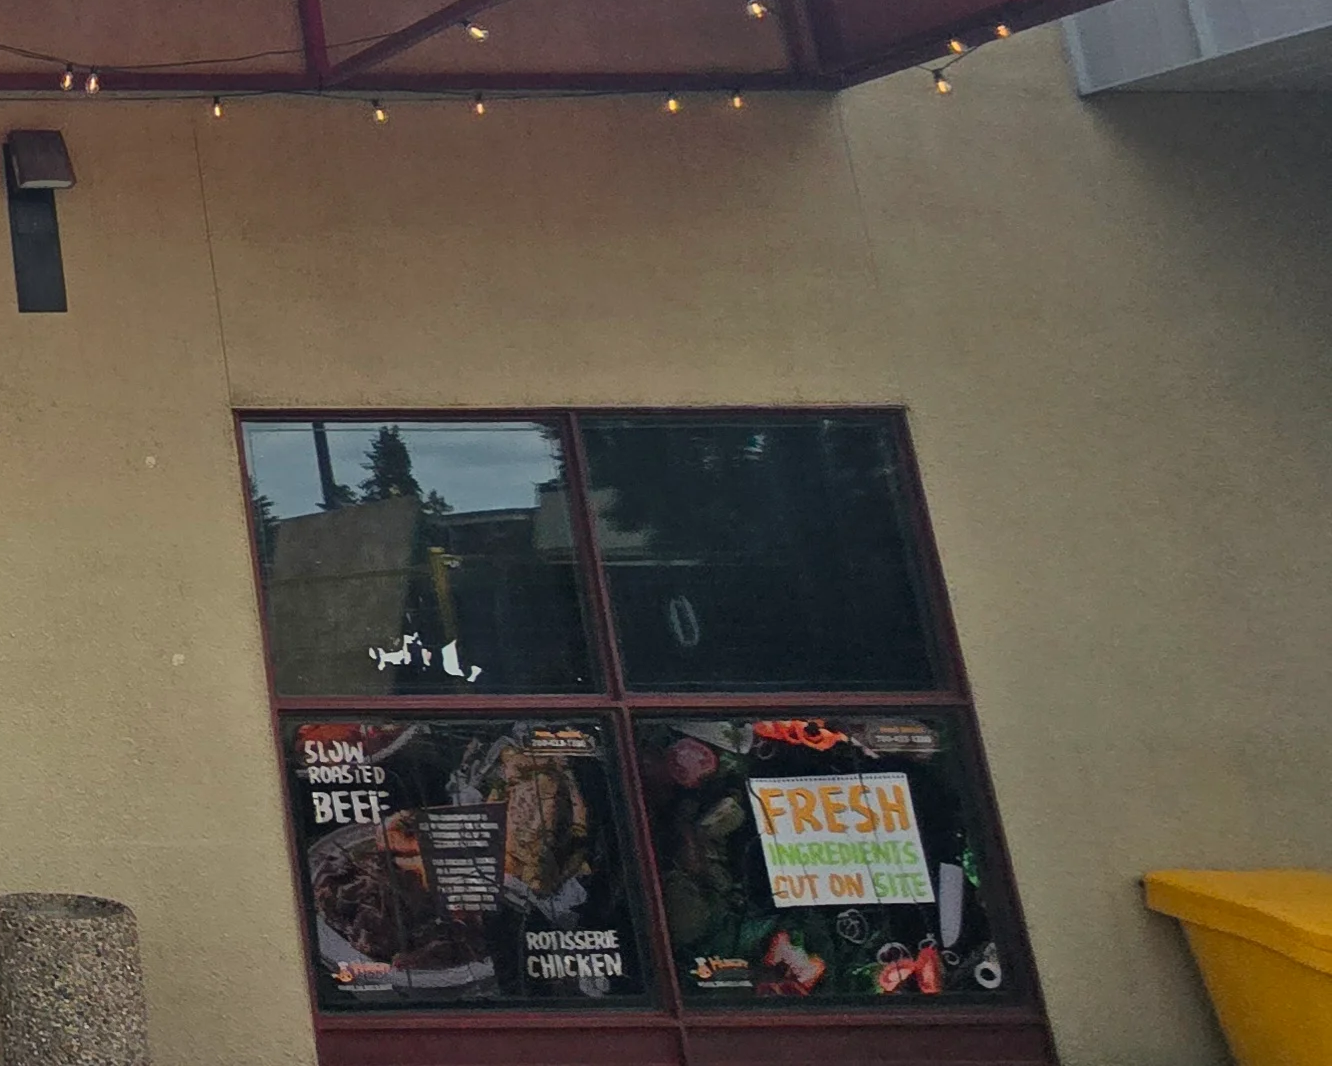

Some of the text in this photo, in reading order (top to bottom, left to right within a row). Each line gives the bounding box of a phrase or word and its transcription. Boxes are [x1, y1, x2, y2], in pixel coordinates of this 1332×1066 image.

[304, 740, 364, 763] SLOW
[307, 765, 385, 785] ROASTED
[313, 790, 390, 824] BEEF
[757, 784, 909, 834] FRESH
[767, 840, 918, 867] INGREDIENTS
[773, 872, 928, 900] CUT ON SITE
[527, 930, 620, 951] ROTISSERIE
[527, 953, 623, 978] CHICKEN
